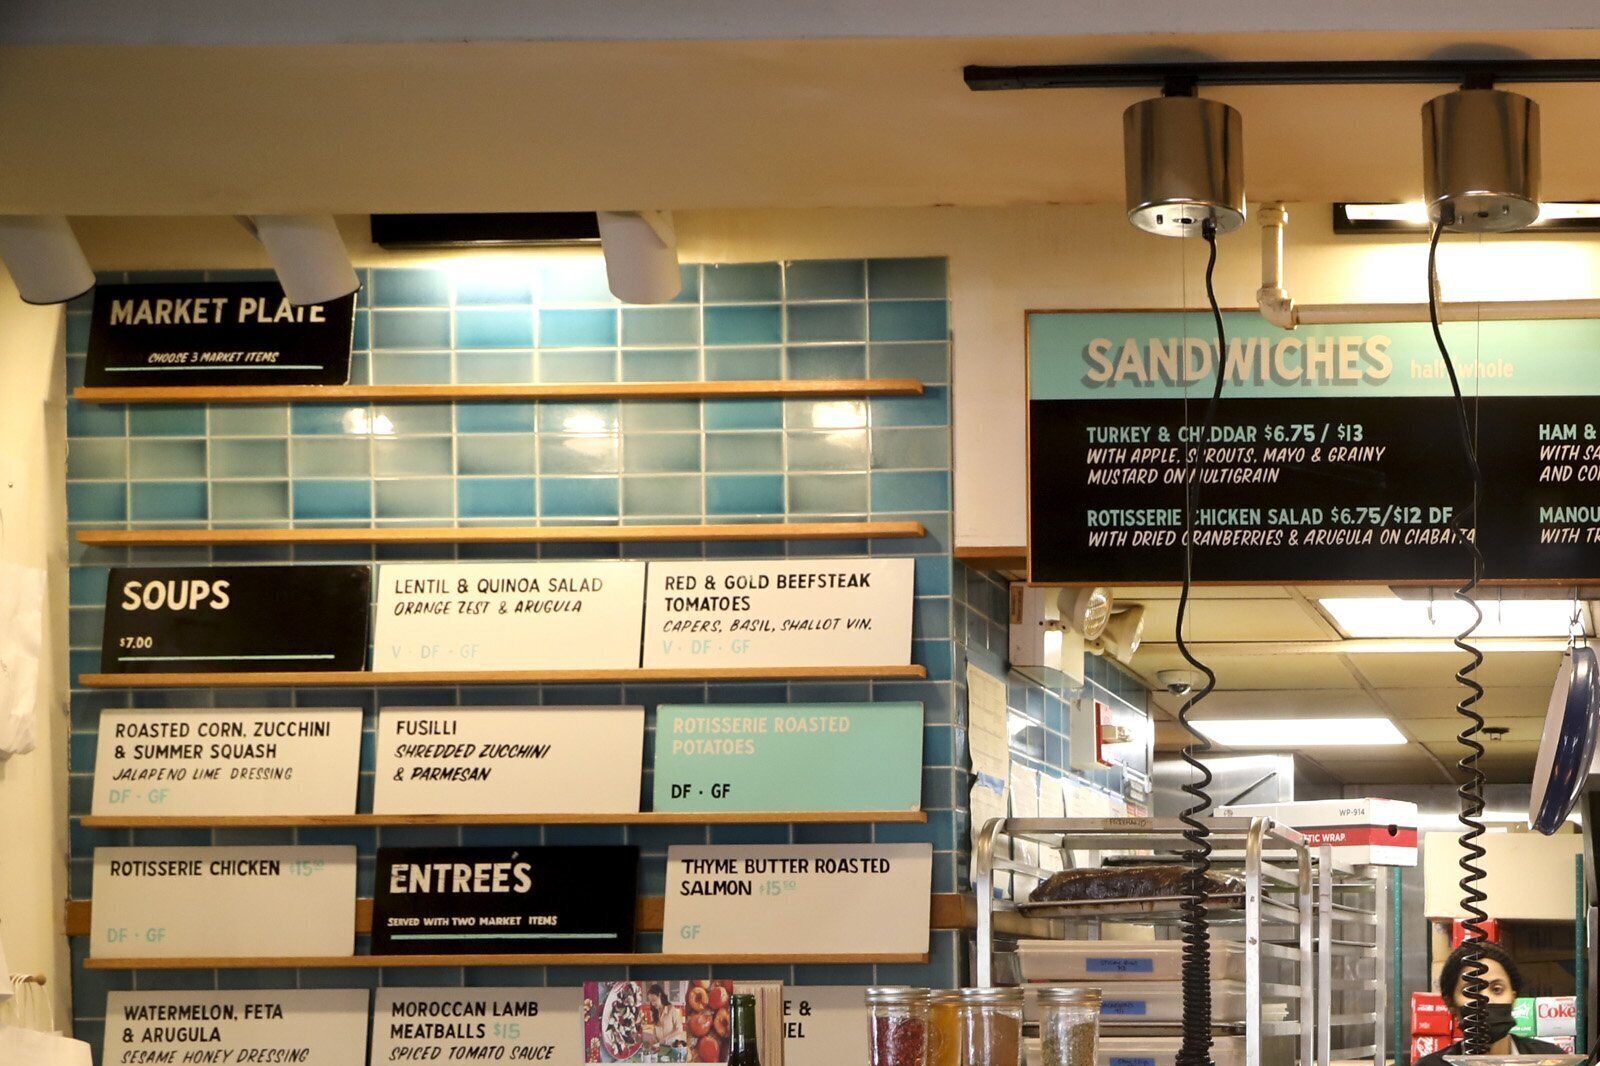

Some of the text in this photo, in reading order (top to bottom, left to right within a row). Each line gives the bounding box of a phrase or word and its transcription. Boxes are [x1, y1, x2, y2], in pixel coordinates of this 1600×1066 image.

[110, 298, 227, 325] MARKET
[148, 352, 279, 364] CHOOSE MARKET ITEMS
[1086, 334, 1514, 382] SANDWICHES whole
[1087, 424, 1363, 443] TURKEY CHDDAR $6.75 $13
[1539, 424, 1577, 440] HAM
[1087, 446, 1385, 464] WITH APPLE, MAYO GRAINY
[1540, 445, 1578, 461] WITH
[1087, 468, 1158, 485] MUSTARD
[1164, 469, 1186, 484] ON
[1539, 466, 1572, 482] AND
[1087, 508, 1323, 527] ROTISSERIE HICKEN SALAD
[1088, 531, 1127, 547] WITH
[1132, 531, 1176, 546] DRIED
[1303, 529, 1372, 545] ARUGULA
[1380, 528, 1400, 544] ON
[1540, 528, 1579, 544] WITH
[395, 578, 603, 594] LENTIL QUINOA SALAD
[665, 573, 871, 590] RED GOLD BEEFSTEAK
[122, 580, 230, 611] SOUPS
[394, 600, 582, 616] ORANGE ZEST ARUGULA
[665, 596, 750, 612] TOMATOES
[663, 618, 872, 633] CAPERS, BASIL, SHALLOT VIN.
[119, 637, 153, 649] $7.00
[116, 721, 330, 738] ROASTED CORN, ZUCCHINI
[396, 720, 457, 735] FUSILLI
[673, 717, 850, 734] ROTISSERIE ROASTED
[134, 744, 277, 759] SUMMER SQUASH
[394, 744, 551, 758] SHREDDED ZUCCHINI
[672, 740, 755, 755] POTATOES
[113, 767, 293, 781] JALAPENO LIME DRESSING
[411, 767, 491, 781] PARMESAN
[1322, 833, 1345, 842] WRAP
[110, 860, 280, 876] ROTISSERIE CHICKEN
[681, 858, 890, 874] THYME BUTTER ROASTED
[680, 880, 752, 896] SALMON
[387, 916, 557, 927] SERVED WITH TWO MARKET ITEMS
[124, 1004, 283, 1021] WATERMELON, FETA
[392, 1001, 538, 1018] MOROCCAN LAMB
[1538, 1004, 1576, 1018] Coke
[141, 1027, 221, 1042] ARUGULA
[391, 1023, 520, 1039] MEATBALLS $15
[121, 1048, 310, 1064] SESAME HONEY DRESSING
[389, 1045, 555, 1061] SPICED TOMATO SAUCE
